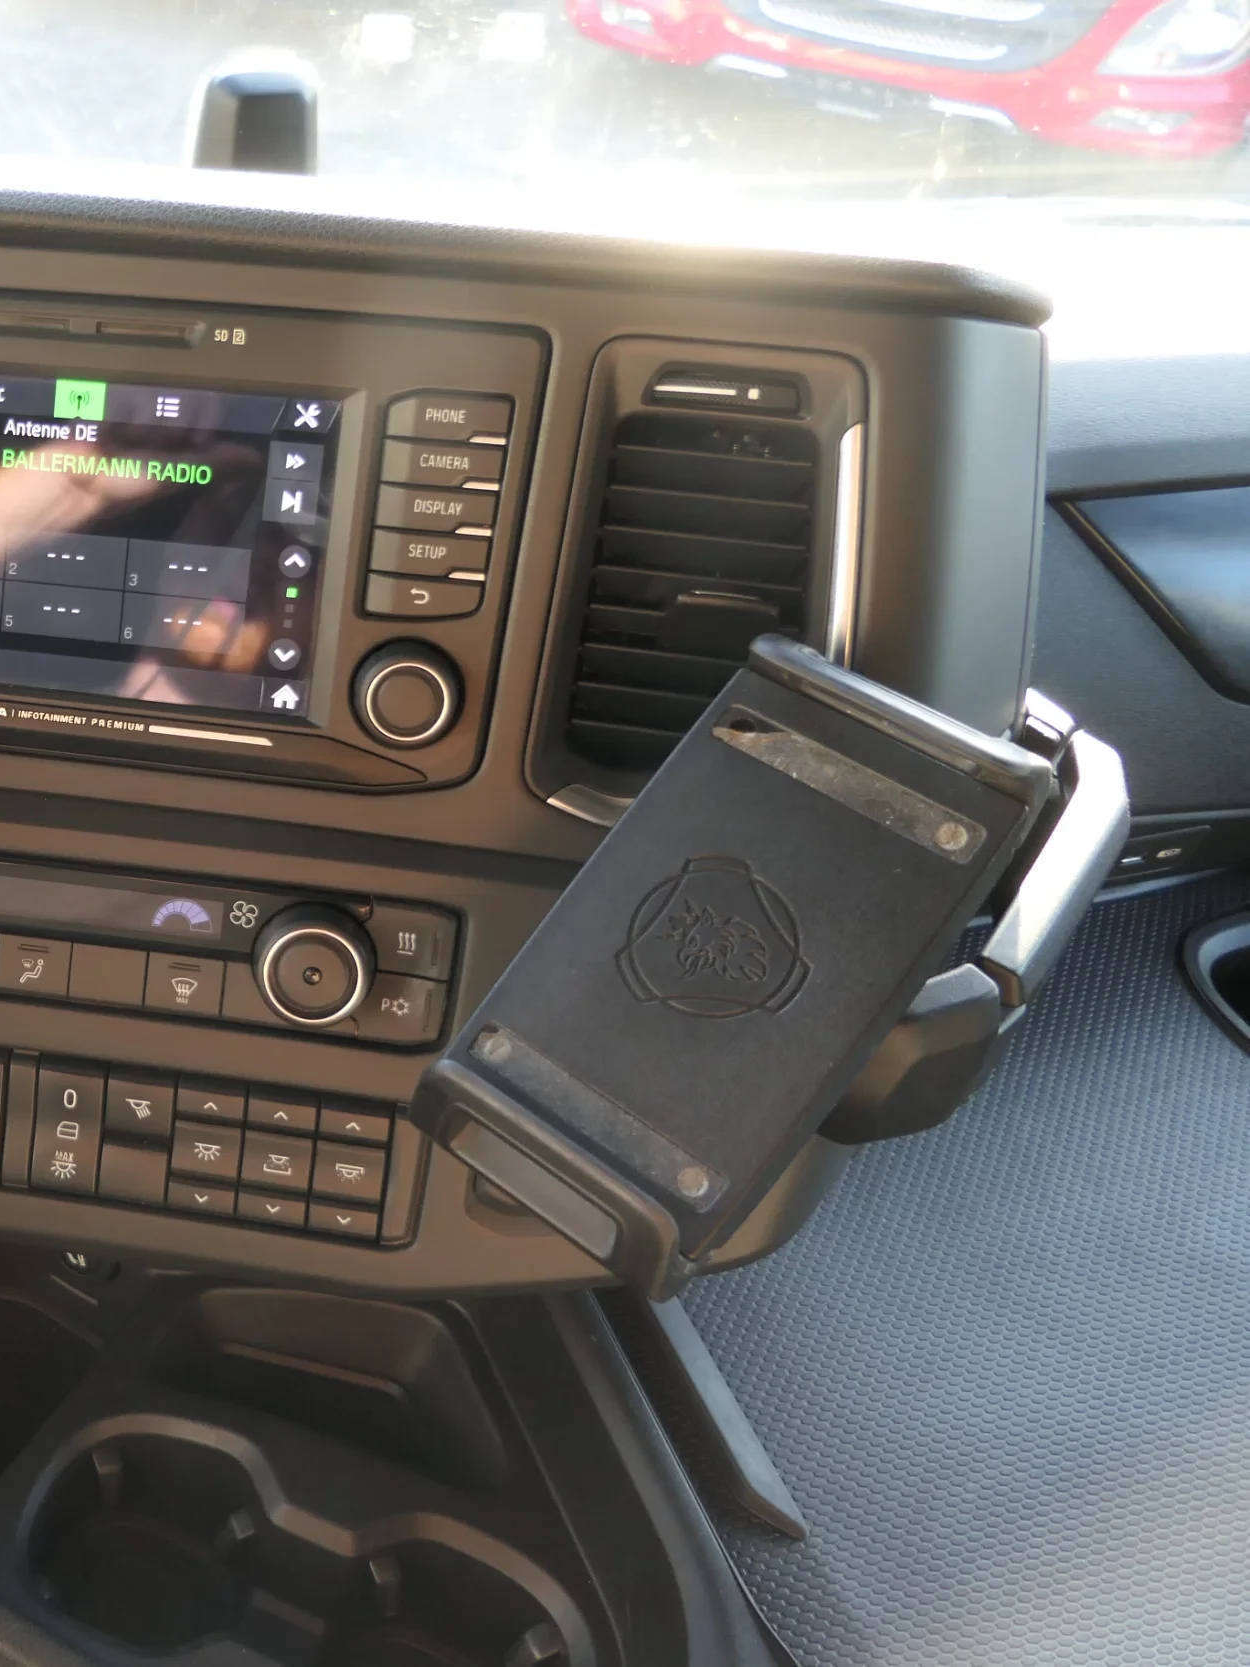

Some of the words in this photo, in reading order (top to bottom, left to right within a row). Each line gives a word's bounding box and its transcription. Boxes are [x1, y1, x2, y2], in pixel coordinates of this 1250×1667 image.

[213, 328, 228, 342] SD
[425, 408, 466, 424] PHONE
[3, 419, 70, 440] Antenne
[75, 424, 98, 442] DE
[1, 448, 141, 479] BALLERMANN
[146, 460, 213, 485] RADIO
[419, 453, 469, 470] CAMERA
[413, 499, 463, 516] DISPLAY
[408, 544, 447, 560] SETUP
[8, 562, 18, 575] 2
[129, 574, 138, 587] 3
[4, 615, 14, 628] 5
[123, 626, 133, 639] 6
[18, 710, 87, 725] INFOTAINMENT
[91, 718, 145, 732] PREMIUM
[381, 998, 391, 1013] P
[54, 1150, 75, 1162] MAX
